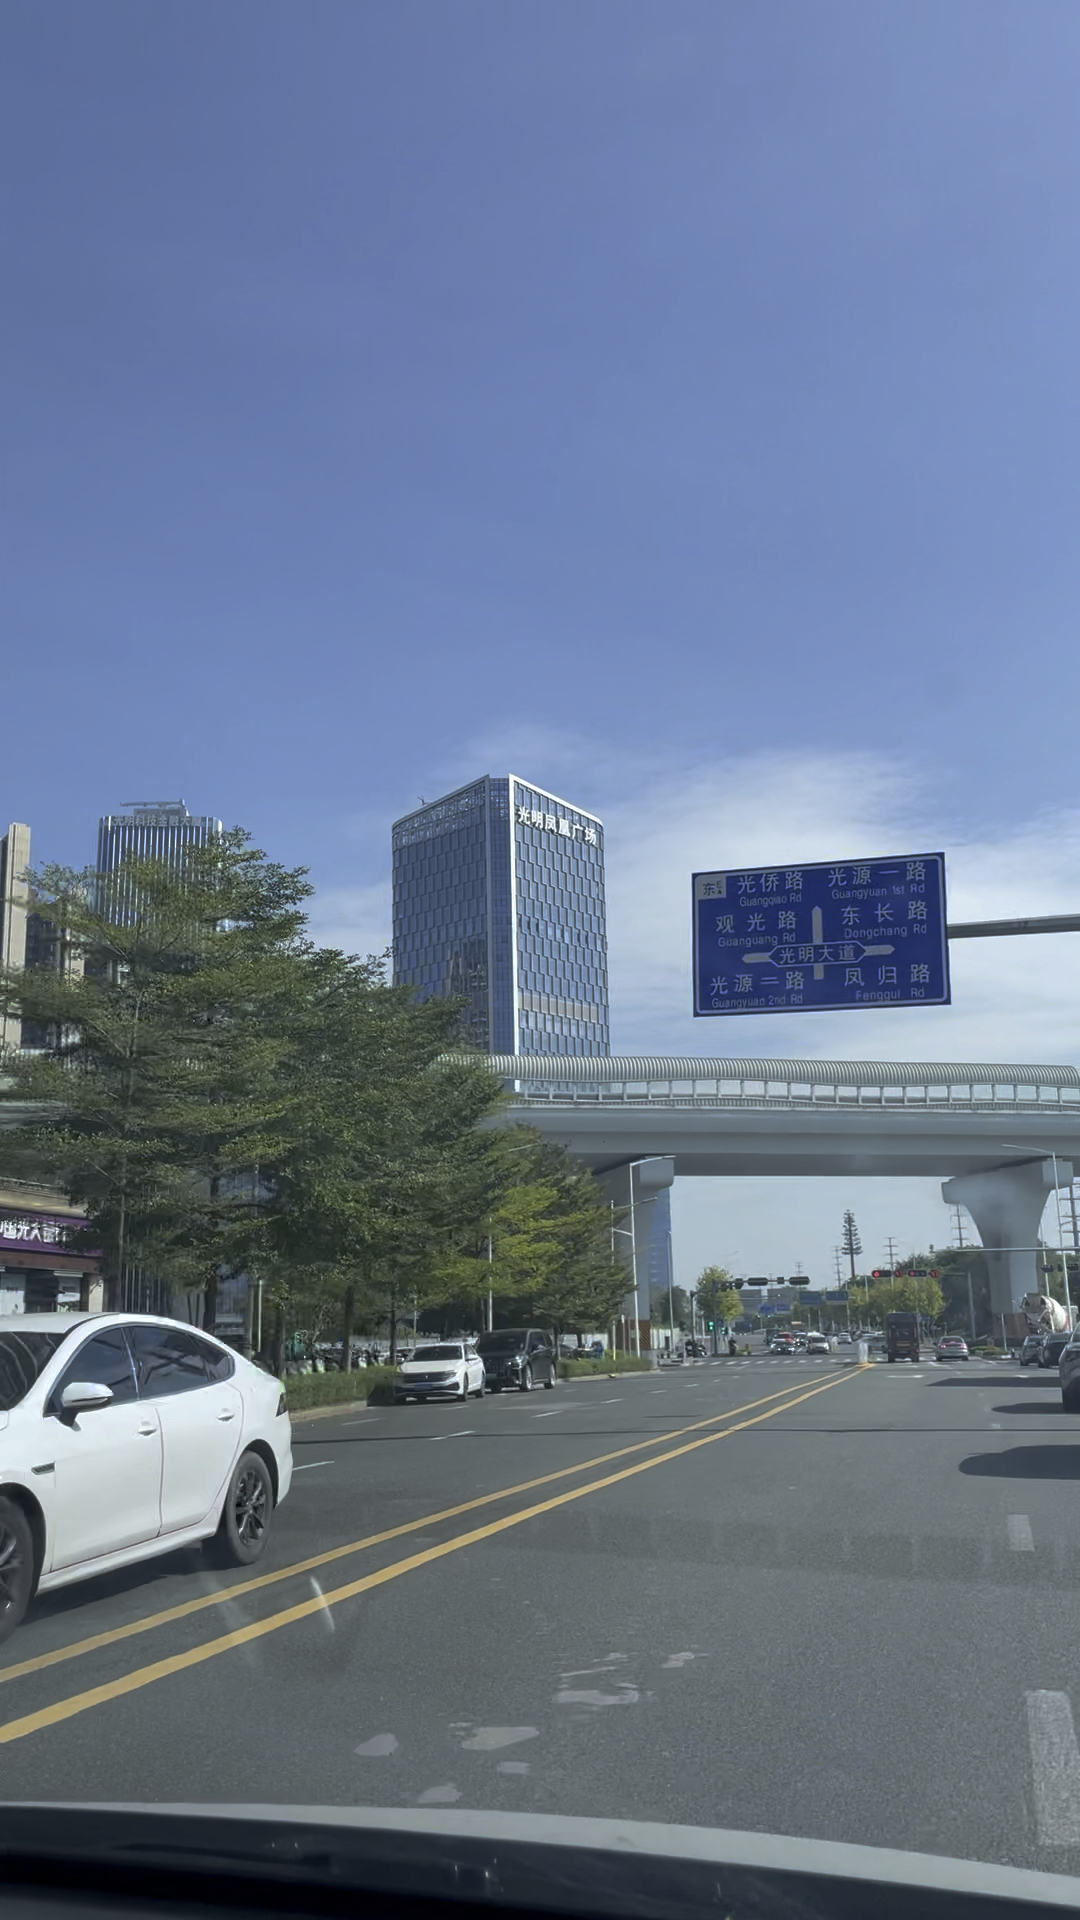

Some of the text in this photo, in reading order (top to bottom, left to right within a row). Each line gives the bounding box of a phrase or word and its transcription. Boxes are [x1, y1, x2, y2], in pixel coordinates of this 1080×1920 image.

[737, 871, 804, 895] 光侨路
[828, 861, 926, 888] 光源一路
[702, 883, 716, 896] 东
[831, 884, 925, 900] Guangyuan 1st Rd
[740, 893, 802, 908] Guangqiao Rd
[715, 911, 797, 934] 观光路
[841, 901, 928, 926] 东长路
[718, 932, 796, 948] Guanguang Rd
[844, 924, 927, 940] Dongchang Rd
[779, 944, 856, 964] 光明大道
[710, 971, 805, 996] 光源二路
[844, 964, 930, 987] 凤归路
[768, 995, 786, 1005] 2nd
[791, 994, 803, 1004] Rd
[911, 988, 924, 998] Rd
